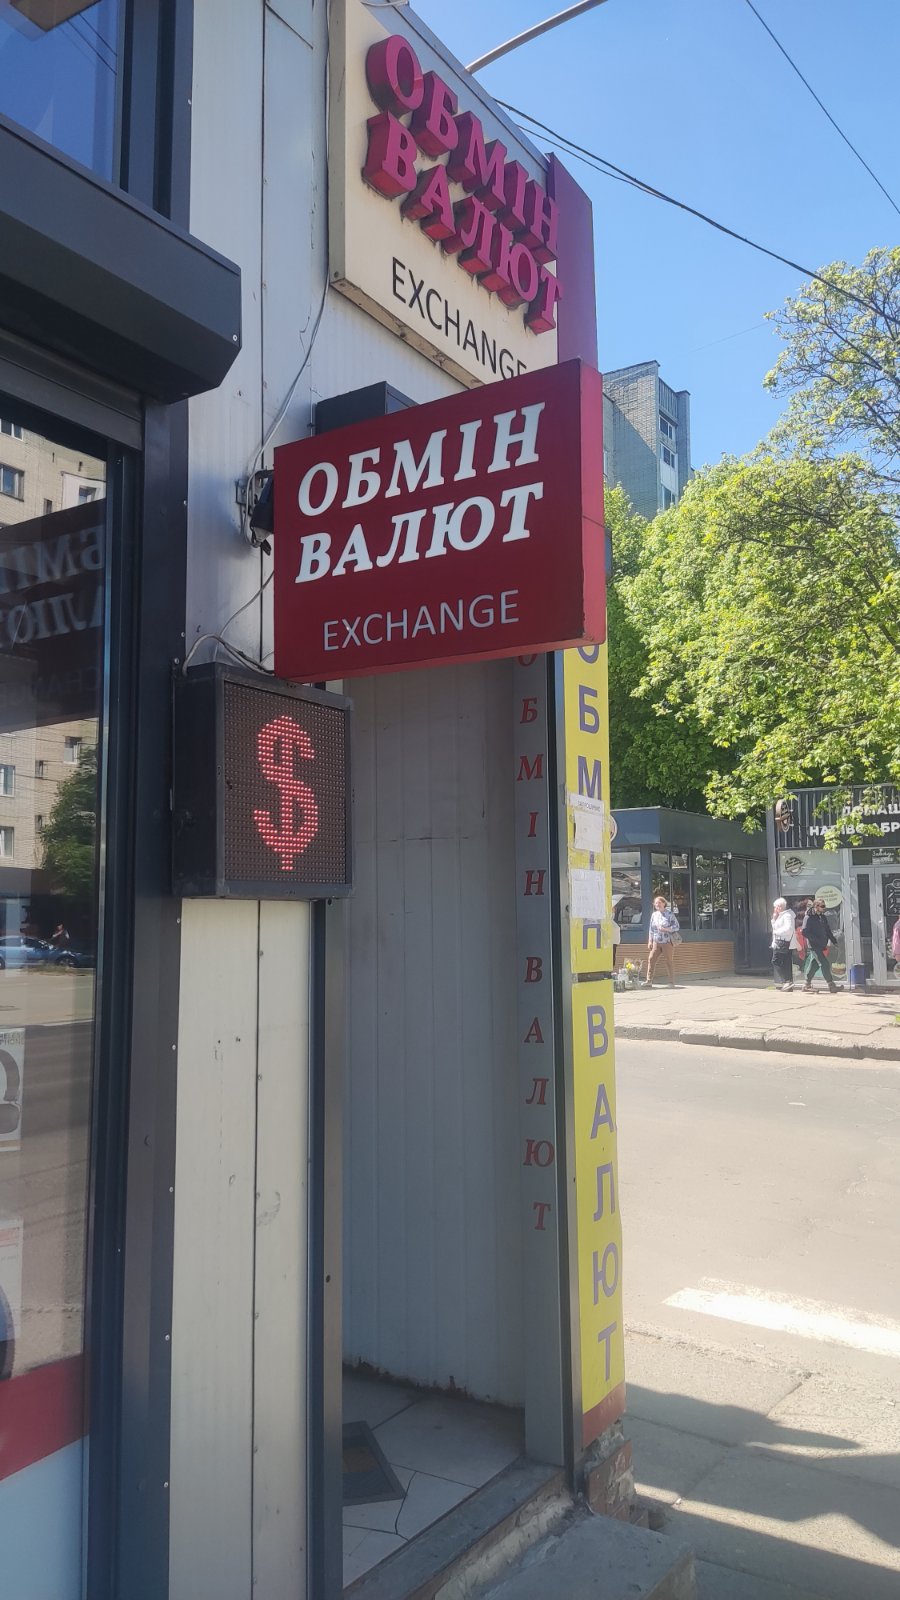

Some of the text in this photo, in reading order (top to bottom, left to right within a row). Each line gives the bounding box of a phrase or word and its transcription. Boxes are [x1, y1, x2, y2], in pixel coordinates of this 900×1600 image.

[364, 112, 562, 333] ВАЛЮТ
[368, 35, 560, 260] ОБМІН
[295, 482, 544, 583] ВАЛЮТ
[298, 402, 545, 516] ОБМІН
[324, 590, 519, 651] EXCHANGE
[254, 715, 318, 870] $
[523, 957, 554, 1230] ВАЛЮТ
[586, 1005, 619, 1382] ВАЛЮТ
